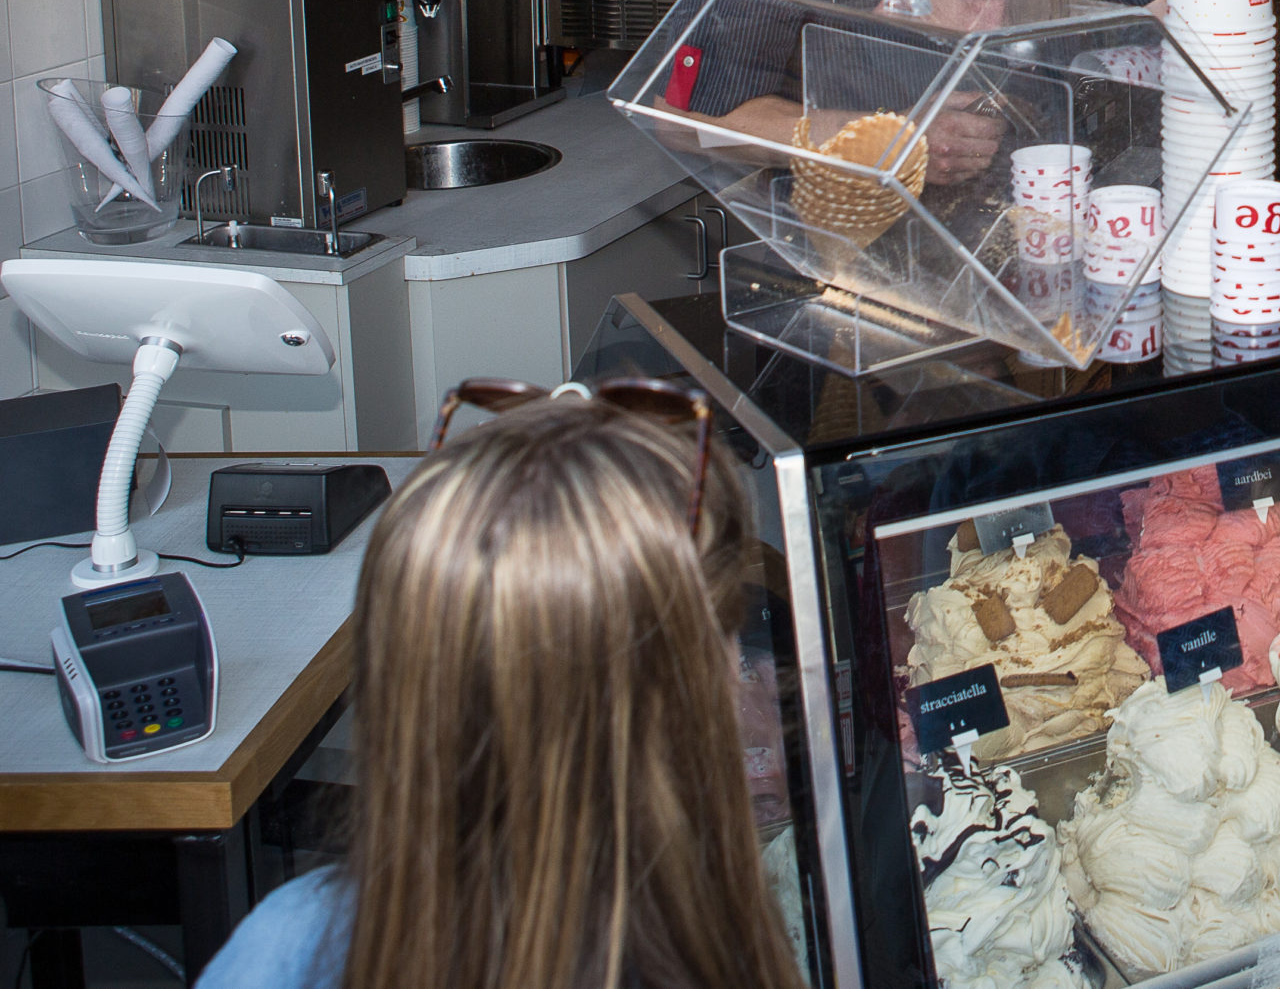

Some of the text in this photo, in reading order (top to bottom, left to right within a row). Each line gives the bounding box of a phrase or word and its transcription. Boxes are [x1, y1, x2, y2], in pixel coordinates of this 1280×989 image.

[1234, 470, 1272, 487] aardbei
[1181, 629, 1217, 653] vanille
[920, 682, 987, 715] stracciatella
